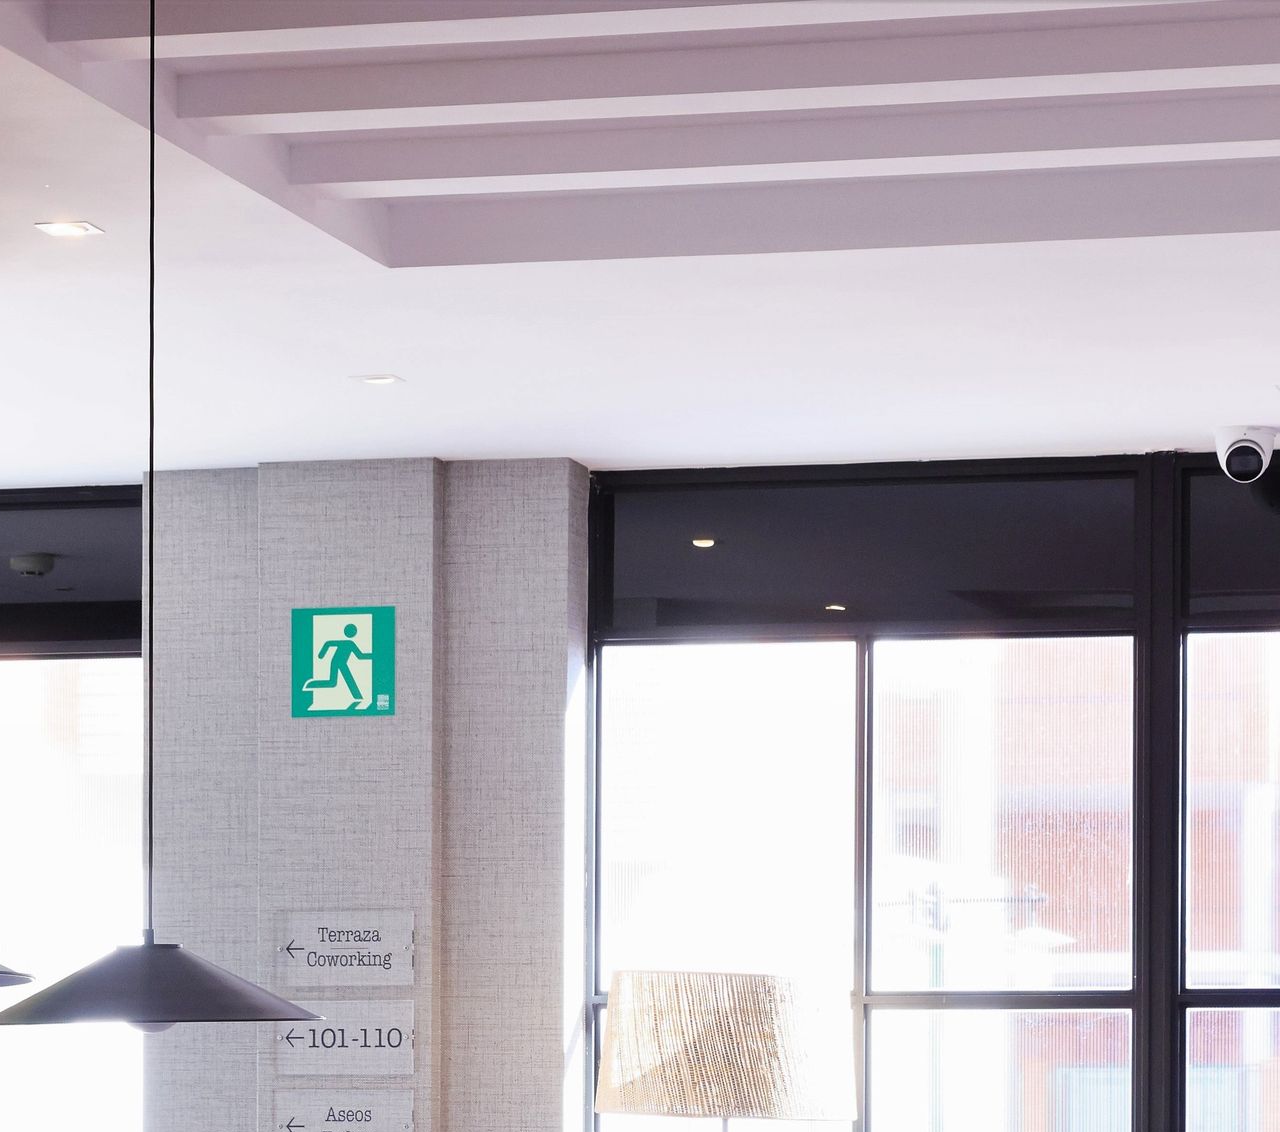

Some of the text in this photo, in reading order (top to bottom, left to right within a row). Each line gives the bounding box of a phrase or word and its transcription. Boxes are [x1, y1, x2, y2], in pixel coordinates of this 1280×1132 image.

[317, 927, 382, 943] Terraza
[306, 951, 393, 970] Coworking
[308, 1027, 403, 1049] 101-110
[324, 1106, 373, 1123] Aseos
